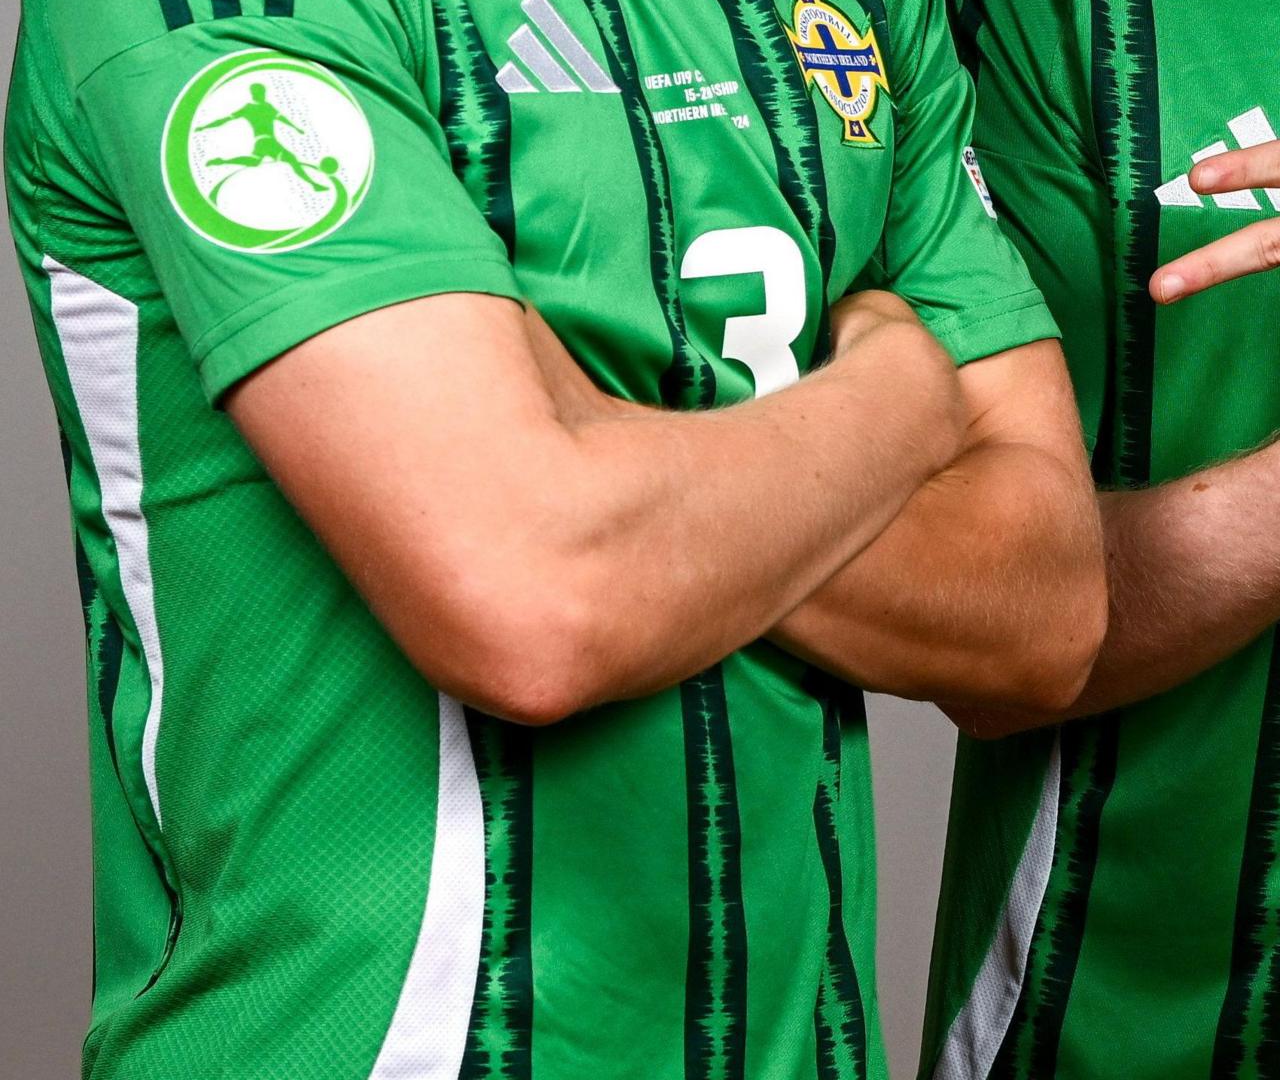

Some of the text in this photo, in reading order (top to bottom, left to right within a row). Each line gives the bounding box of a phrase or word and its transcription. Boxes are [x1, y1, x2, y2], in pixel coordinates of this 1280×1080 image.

[808, 7, 853, 44] FOOTBALL
[804, 52, 869, 67] NORTHERN IRELAND
[644, 73, 673, 90] UEFA
[672, 69, 692, 86] U19
[823, 84, 870, 116] ASSOCIATION
[652, 104, 709, 125] NORTHERN
[680, 225, 807, 400] 3
